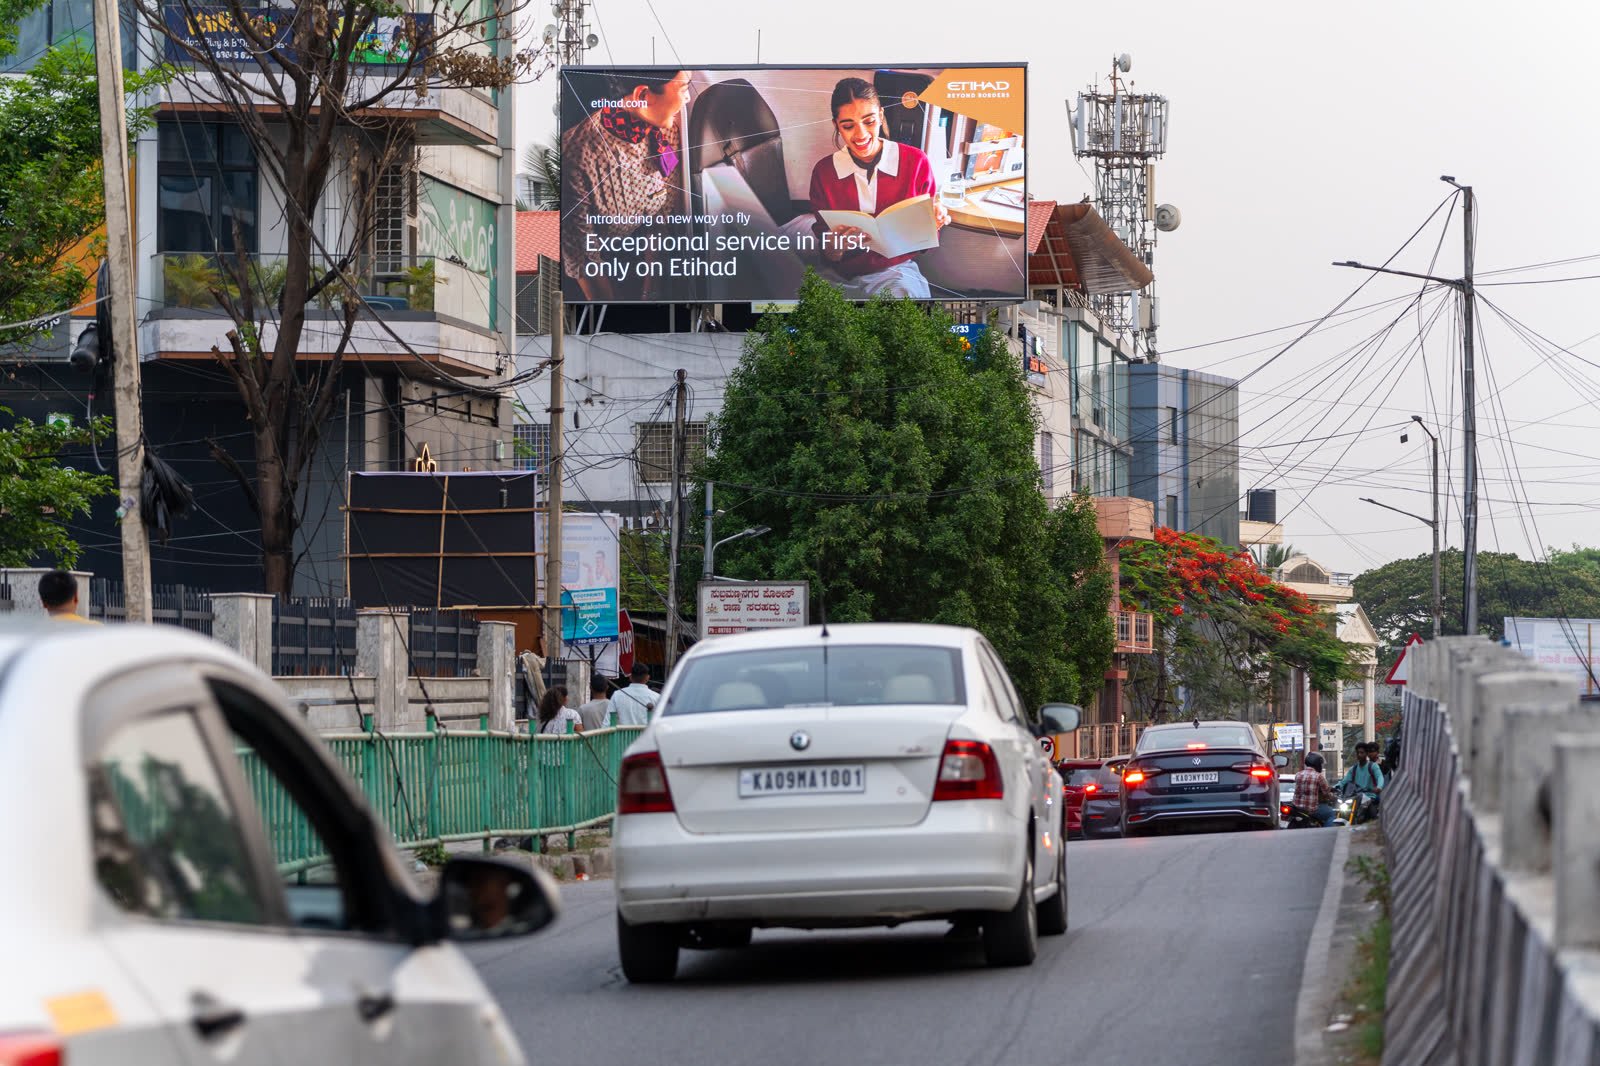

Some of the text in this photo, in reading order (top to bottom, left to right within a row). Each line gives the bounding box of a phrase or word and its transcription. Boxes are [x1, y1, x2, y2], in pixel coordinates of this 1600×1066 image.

[946, 81, 1010, 91] ETIHAD
[590, 98, 648, 108] etihad.com
[585, 212, 751, 227] Introducing a new way to fly
[585, 231, 871, 255] Exceptional service in First,
[585, 256, 737, 281] only on Etihad
[578, 612, 601, 620] Layout
[618, 629, 633, 656] TOP
[752, 768, 862, 791] KA09MA1001
[1175, 772, 1218, 783] KA03NY1027
